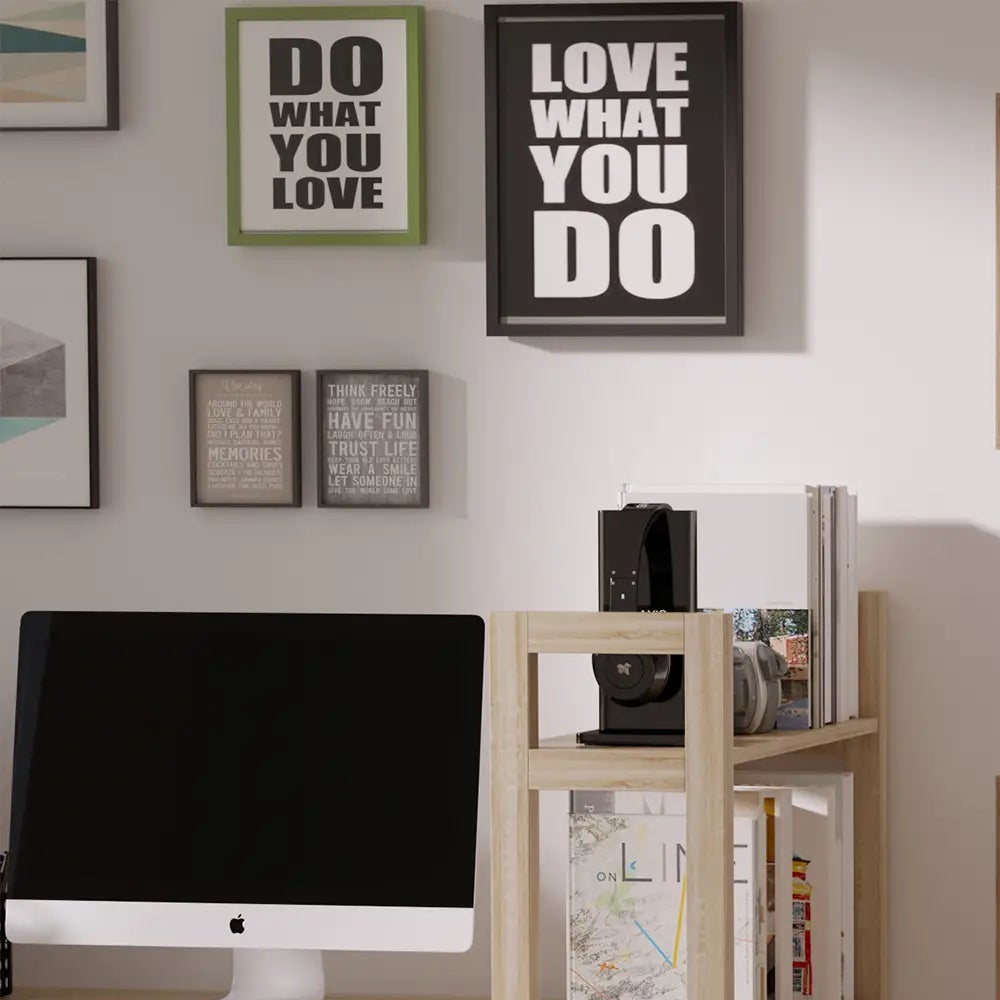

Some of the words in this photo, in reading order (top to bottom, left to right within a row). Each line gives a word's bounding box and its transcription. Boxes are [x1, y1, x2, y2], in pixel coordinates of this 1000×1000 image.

[269, 36, 383, 96] DO
[531, 41, 689, 93] LOVE
[269, 101, 382, 127] WHAT
[529, 98, 689, 138] WHAT
[269, 133, 381, 173] YOU
[528, 144, 688, 205] YOU
[273, 176, 383, 210] LOVE
[533, 208, 695, 299] DO
[328, 384, 366, 397] THINK
[371, 384, 417, 397] FREELY
[208, 408, 231, 417] LOVE
[236, 408, 244, 417] &
[248, 408, 281, 417] FAMILY
[328, 412, 374, 430] HAVE
[382, 412, 417, 430] FUN
[208, 430, 221, 438] DID
[230, 430, 252, 438] PLAN
[256, 430, 282, 439] THAT?
[328, 431, 354, 439] LAUGH
[358, 431, 384, 439] OFTEN
[397, 431, 417, 439] LOUD
[208, 447, 282, 461] MEMORIES
[328, 441, 378, 457] TRUST
[385, 441, 417, 457] LIFE
[328, 464, 361, 475] WEAR
[368, 464, 375, 475] A
[383, 464, 417, 475] SMILE
[328, 476, 349, 487] LET
[352, 475, 403, 487] SOMEONE
[407, 476, 417, 487] IN
[596, 872, 617, 882] ON
